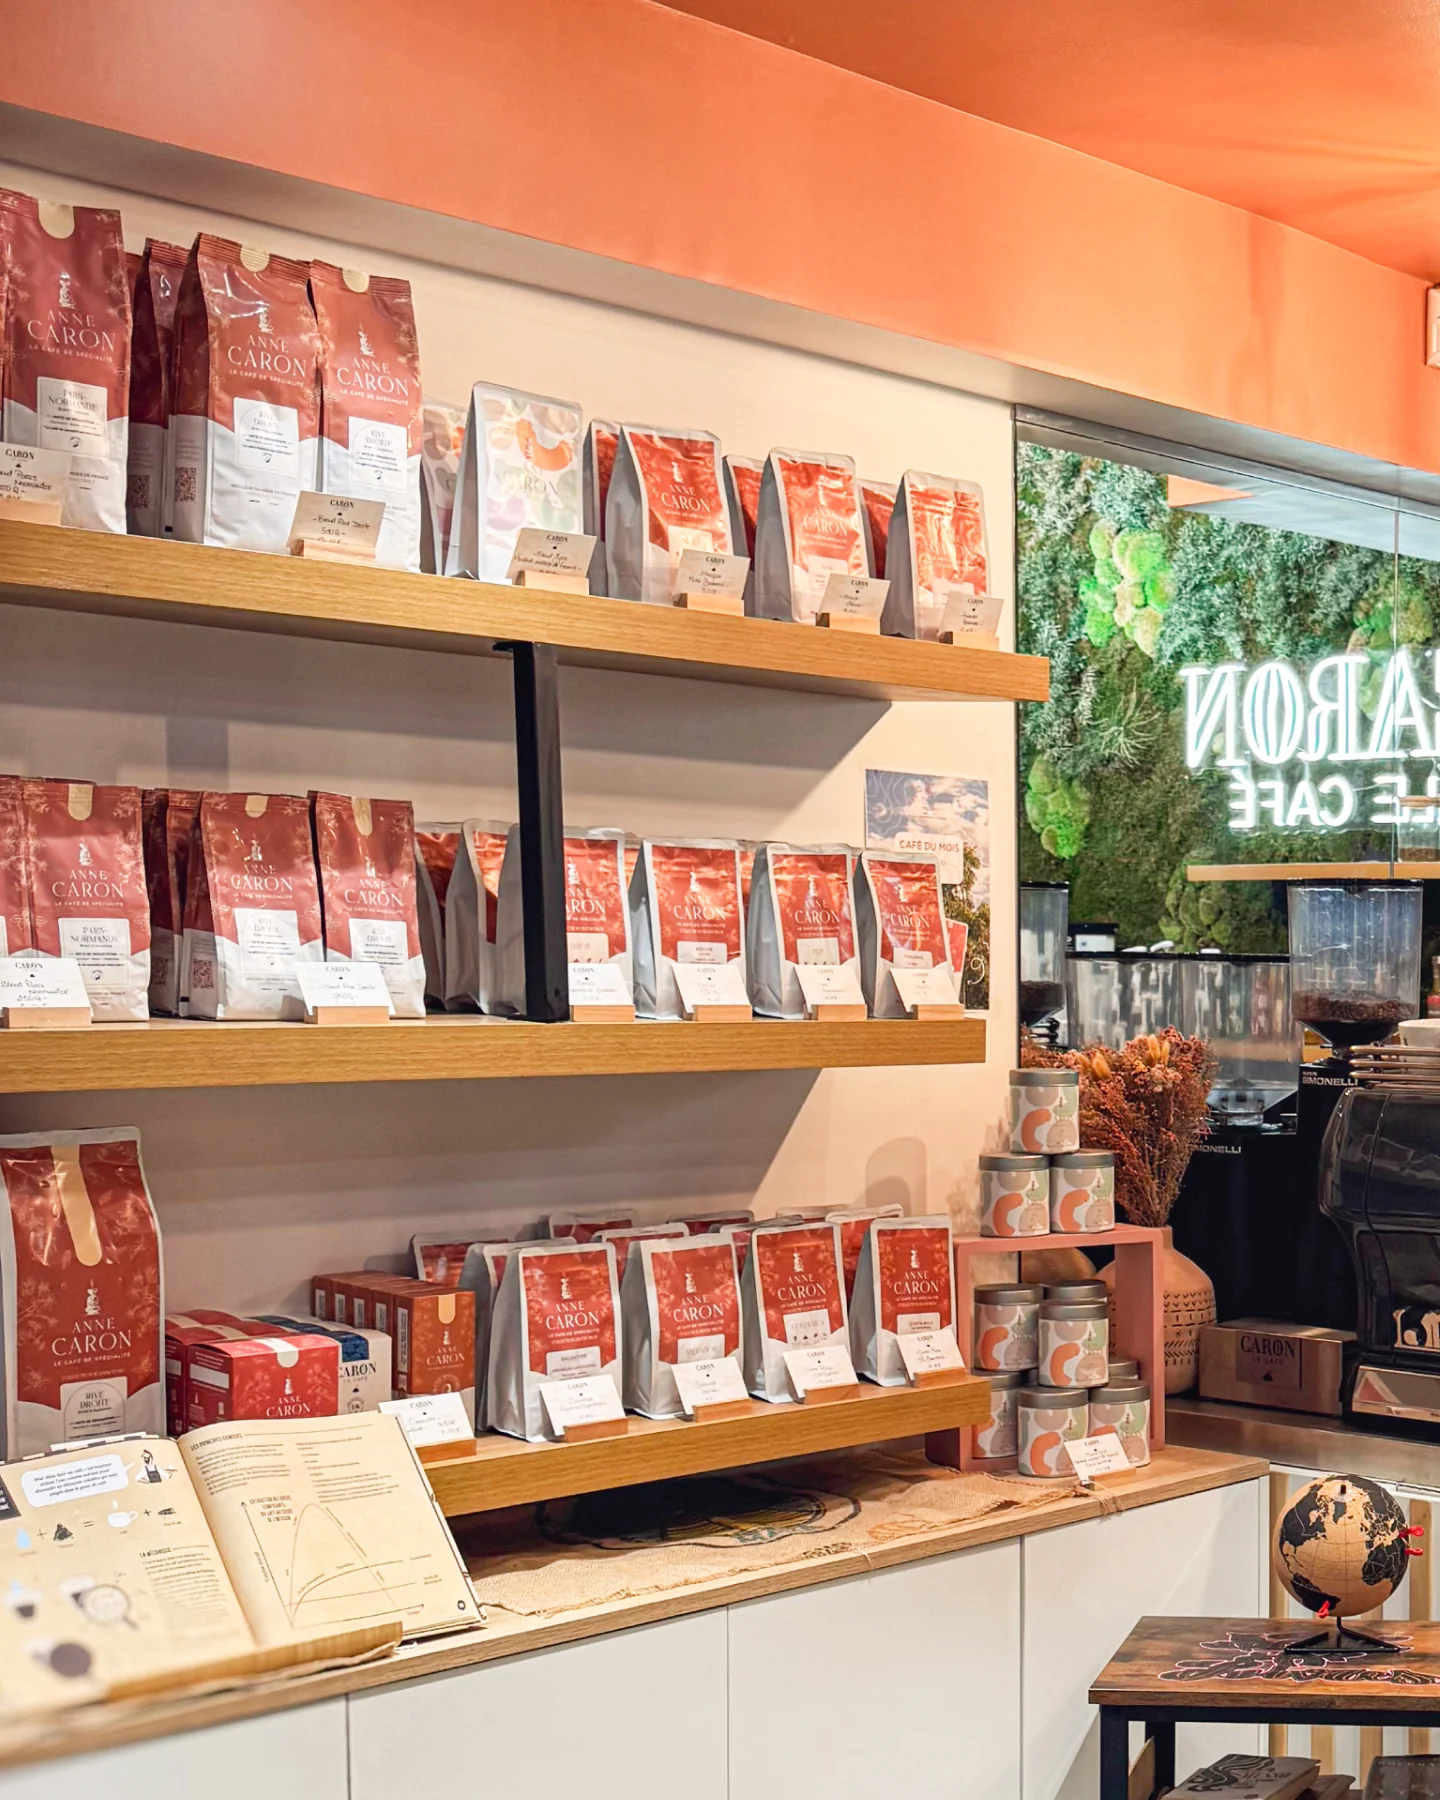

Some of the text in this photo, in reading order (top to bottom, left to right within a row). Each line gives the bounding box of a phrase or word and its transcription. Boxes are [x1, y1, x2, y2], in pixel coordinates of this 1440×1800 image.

[48, 310, 95, 328] ANNE
[28, 320, 116, 353] CARON
[247, 335, 289, 353] ANNE
[227, 345, 307, 378] CARON
[352, 357, 391, 374] ANNE
[337, 367, 410, 397] CARON
[5, 448, 35, 460] CARON
[330, 499, 354, 509] CARON
[661, 491, 711, 514] CARON
[803, 516, 850, 537] CARON
[899, 839, 961, 853] CAFÉ DU MOIS
[69, 869, 108, 880] ANNE
[52, 881, 125, 899] CARON
[230, 874, 294, 893] CARON
[359, 879, 389, 891] ANNE
[344, 889, 406, 907] CARON
[565, 886, 593, 899] NNE
[673, 904, 727, 920] CARON
[794, 909, 841, 924] CARON
[889, 912, 931, 929] CARON
[15, 961, 44, 970] CARON
[787, 1273, 815, 1286] ANNE
[904, 1270, 930, 1280] ANNE
[777, 1283, 827, 1301] CARON
[893, 1279, 940, 1295] CARON
[555, 1301, 586, 1312] ANNE
[681, 1294, 709, 1306] ANNE
[546, 1310, 600, 1331] CARON
[673, 1302, 725, 1323] CARON
[71, 1317, 116, 1334] ANNE
[1392, 1307, 1419, 1348] La
[51, 1329, 132, 1357] CARON
[1240, 1334, 1297, 1359] CARON
[53, 1359, 62, 1368] LE
[83, 1355, 93, 1364] DE
[426, 1353, 466, 1366] CARON
[266, 1402, 312, 1419] CARON
